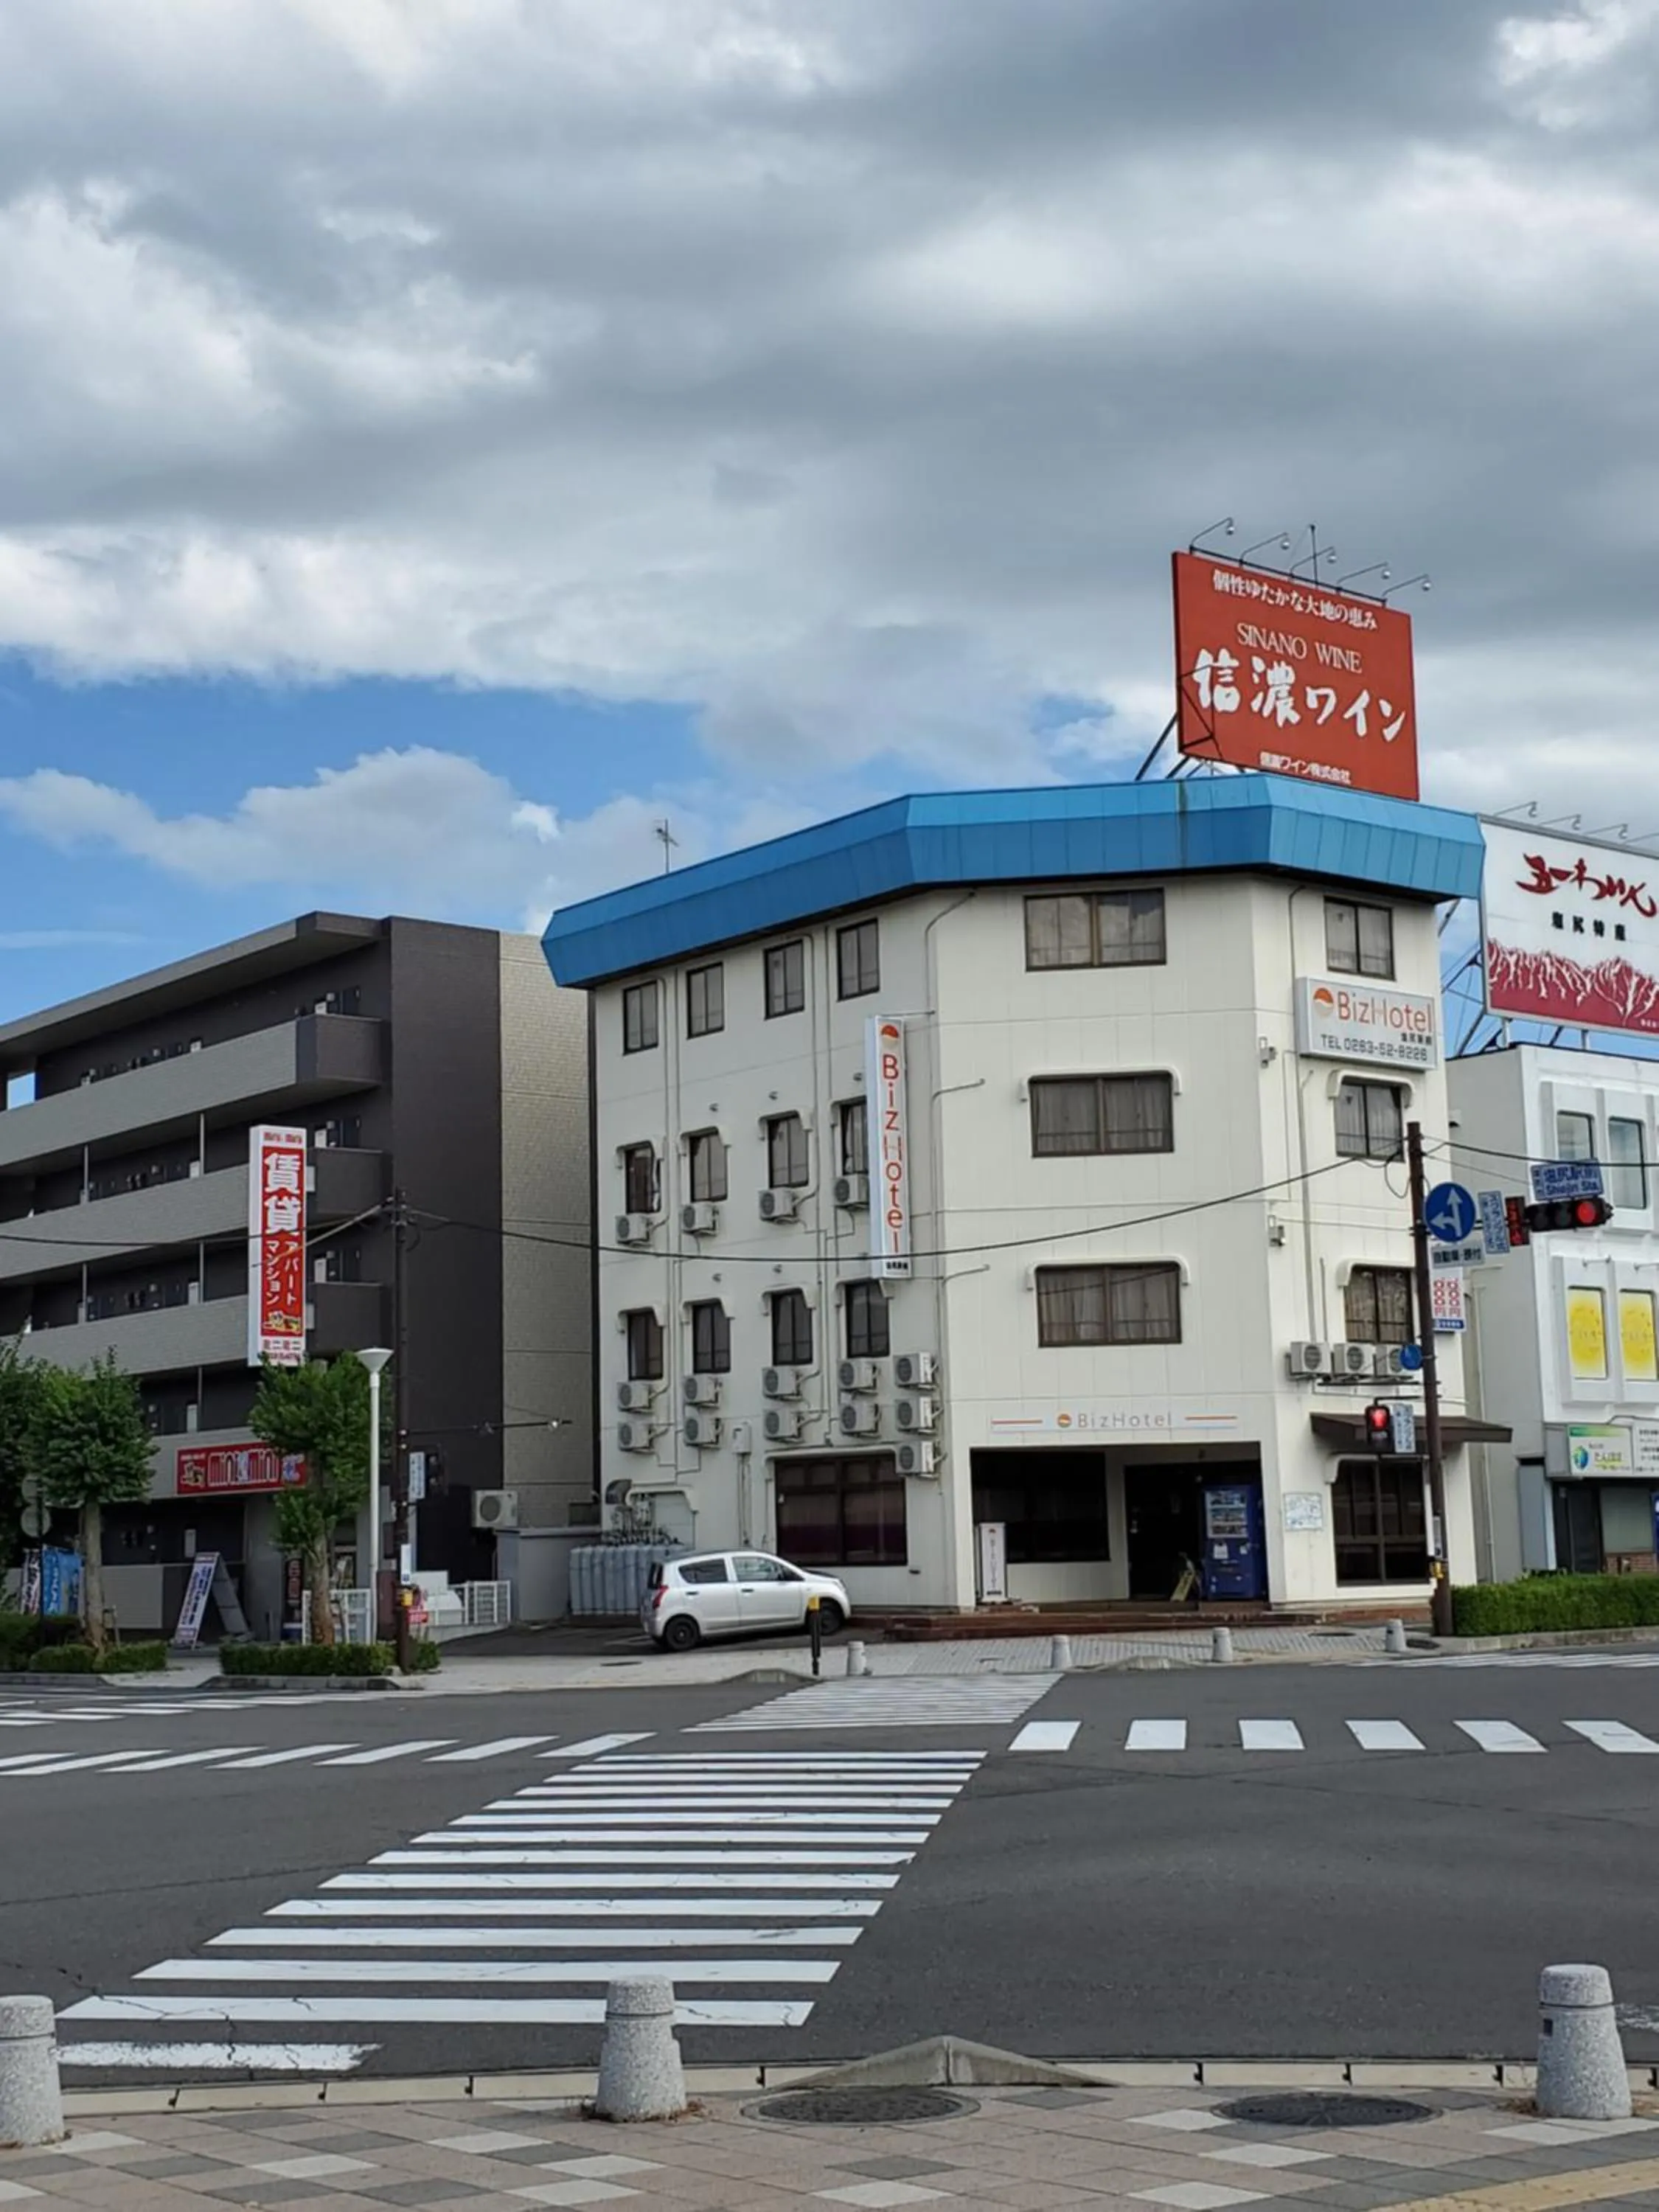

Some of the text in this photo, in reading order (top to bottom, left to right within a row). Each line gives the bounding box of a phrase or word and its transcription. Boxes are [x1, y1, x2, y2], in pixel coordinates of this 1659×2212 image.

[1212, 568, 1378, 630] 個性ゆたかな大地の恵み
[1237, 622, 1363, 674] SINANO WINE
[1192, 648, 1405, 742] 信濃ワイン
[1321, 1034, 1341, 1049] TEL
[1338, 990, 1432, 1033] BizHotel
[882, 1053, 903, 1253] BizHotel
[263, 1152, 302, 1235] 賃貸
[265, 1240, 282, 1305] マンション
[284, 1240, 300, 1307] アパート
[1078, 1410, 1171, 1428] BizHotel
